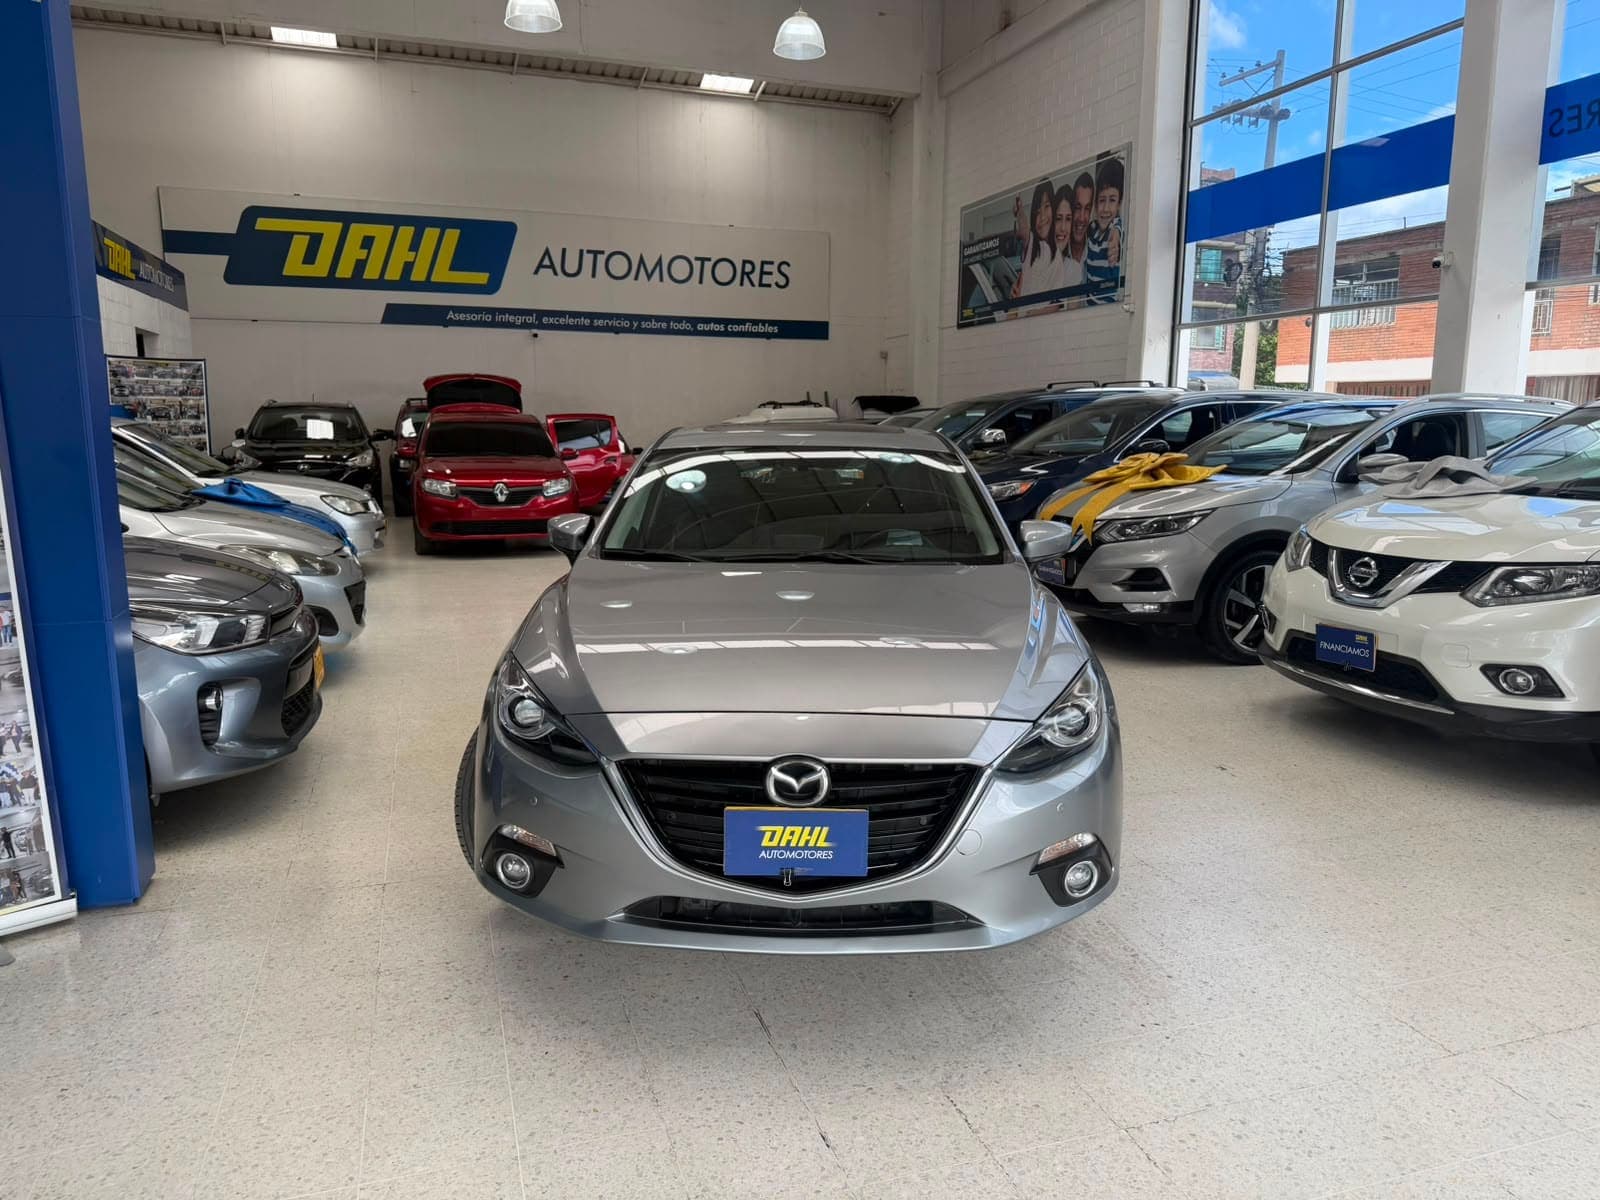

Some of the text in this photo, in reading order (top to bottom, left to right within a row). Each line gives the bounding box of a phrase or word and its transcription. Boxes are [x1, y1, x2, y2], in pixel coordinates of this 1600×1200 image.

[103, 236, 136, 280] DAHL
[254, 217, 791, 289] DAHL AUTOMOTORES
[495, 312, 538, 325] integral,
[542, 314, 591, 326] excelente
[593, 317, 630, 328] servicio
[632, 320, 639, 330] y
[640, 318, 667, 329] sobre
[670, 320, 694, 332] todo,
[696, 321, 725, 332] autos
[727, 322, 778, 334] confiables
[1319, 641, 1370, 657] FINANCIAMOS
[756, 825, 837, 848] DAHL
[758, 850, 834, 860] AUTOMOTORES
